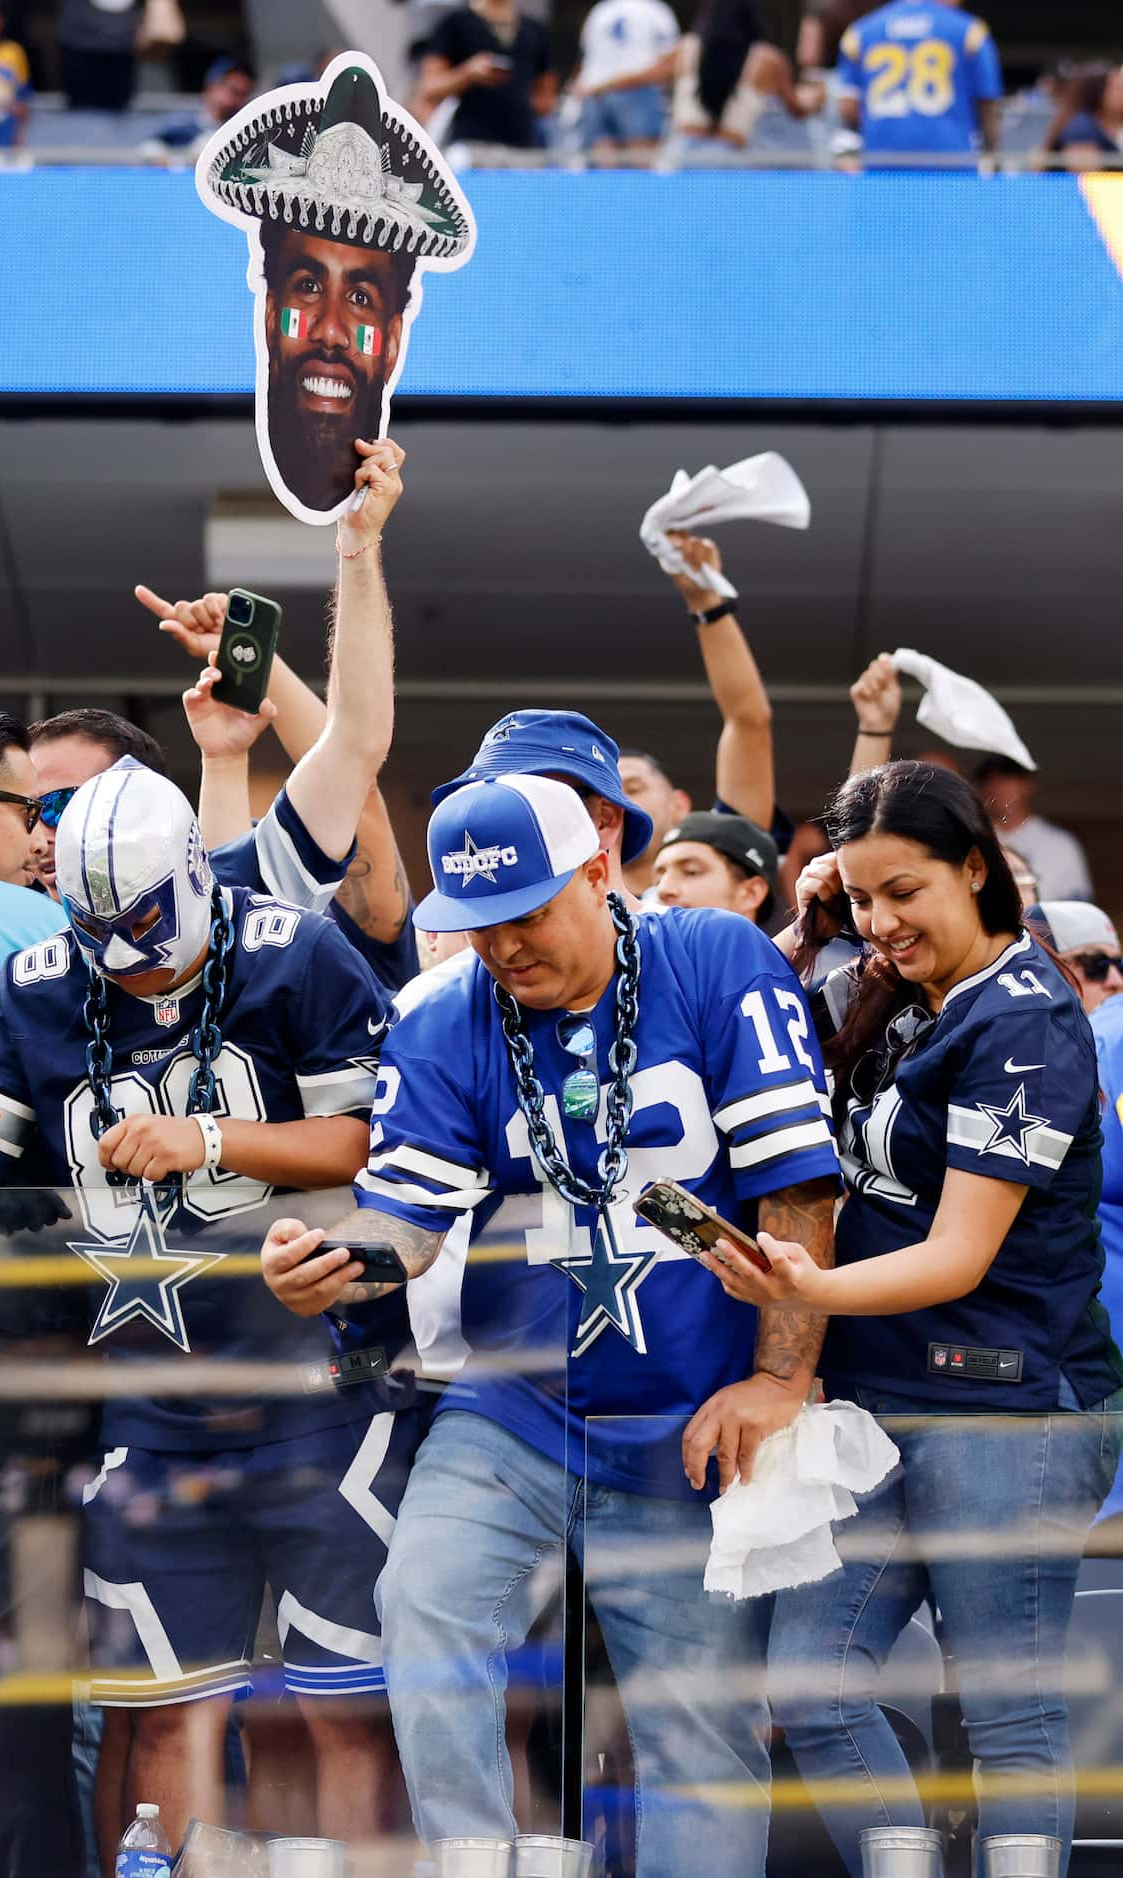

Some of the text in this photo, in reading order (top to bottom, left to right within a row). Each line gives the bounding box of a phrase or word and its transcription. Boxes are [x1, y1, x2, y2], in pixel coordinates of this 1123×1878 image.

[863, 42, 955, 119] 28
[158, 1008, 176, 1021] NFL
[740, 987, 816, 1076] 12
[505, 1060, 719, 1266] 12
[350, 1356, 362, 1369] M
